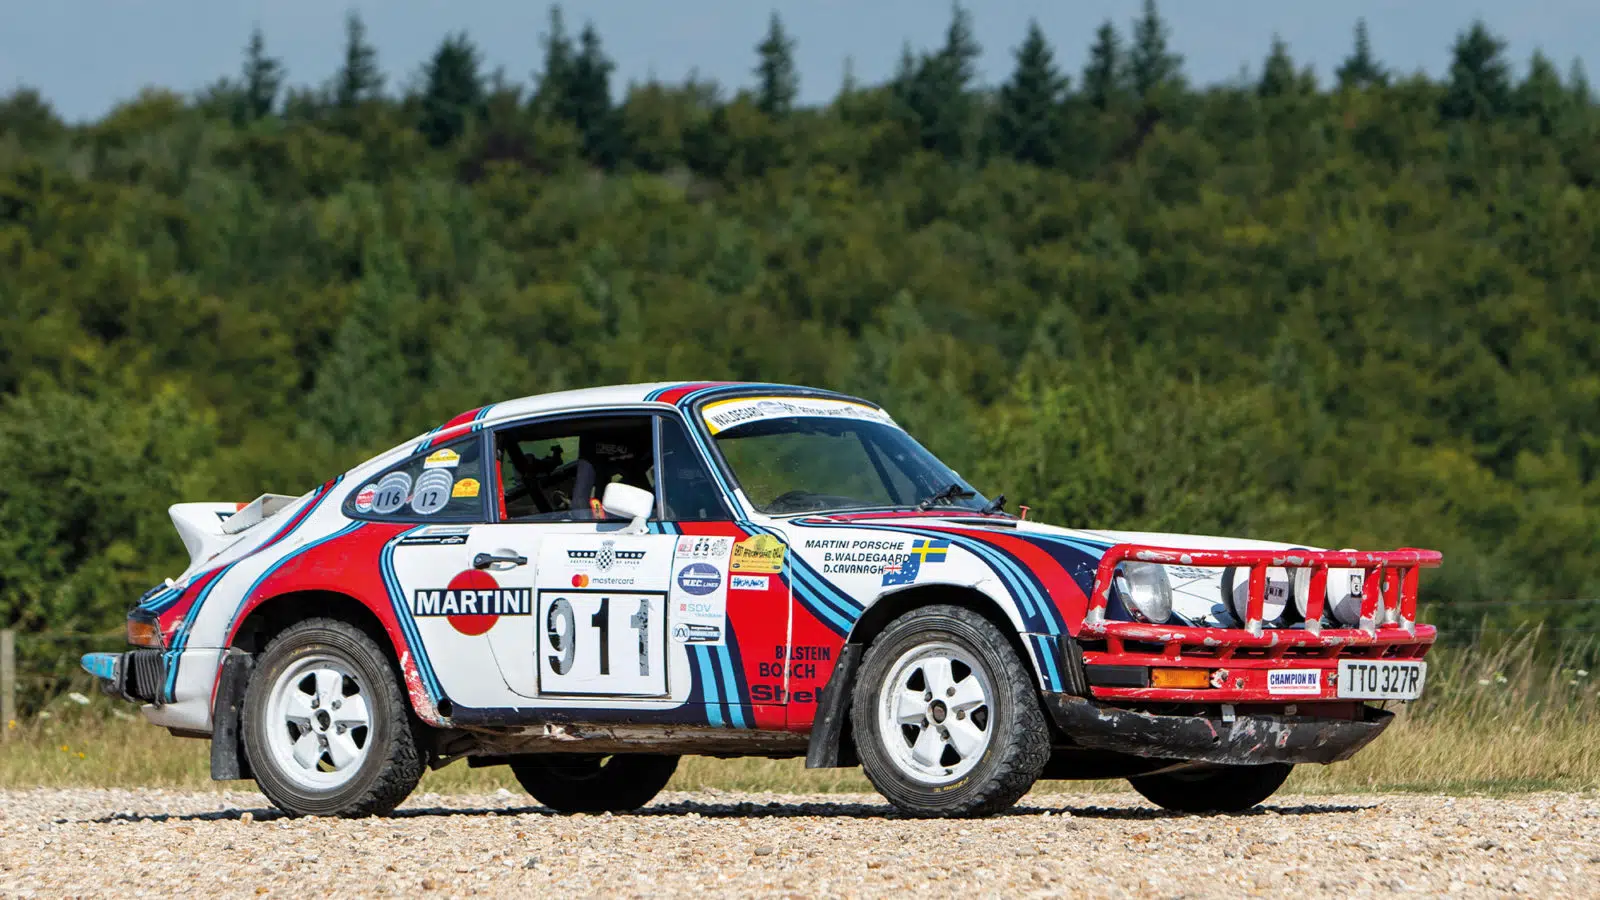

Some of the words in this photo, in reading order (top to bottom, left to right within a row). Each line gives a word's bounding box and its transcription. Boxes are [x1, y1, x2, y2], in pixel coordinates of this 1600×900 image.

[376, 491, 401, 507] 116
[422, 492, 438, 507] 12
[805, 540, 850, 549] MARTINI
[852, 540, 906, 551] PORSCHE
[592, 575, 635, 585] mastercard
[416, 589, 530, 615] MARTINI
[547, 597, 650, 676] 911
[1270, 673, 1307, 685] CHAMPION
[1308, 673, 1318, 684] RV
[1347, 664, 1378, 692] TTO
[1381, 665, 1420, 693] 327R
[751, 684, 823, 703] Shel
